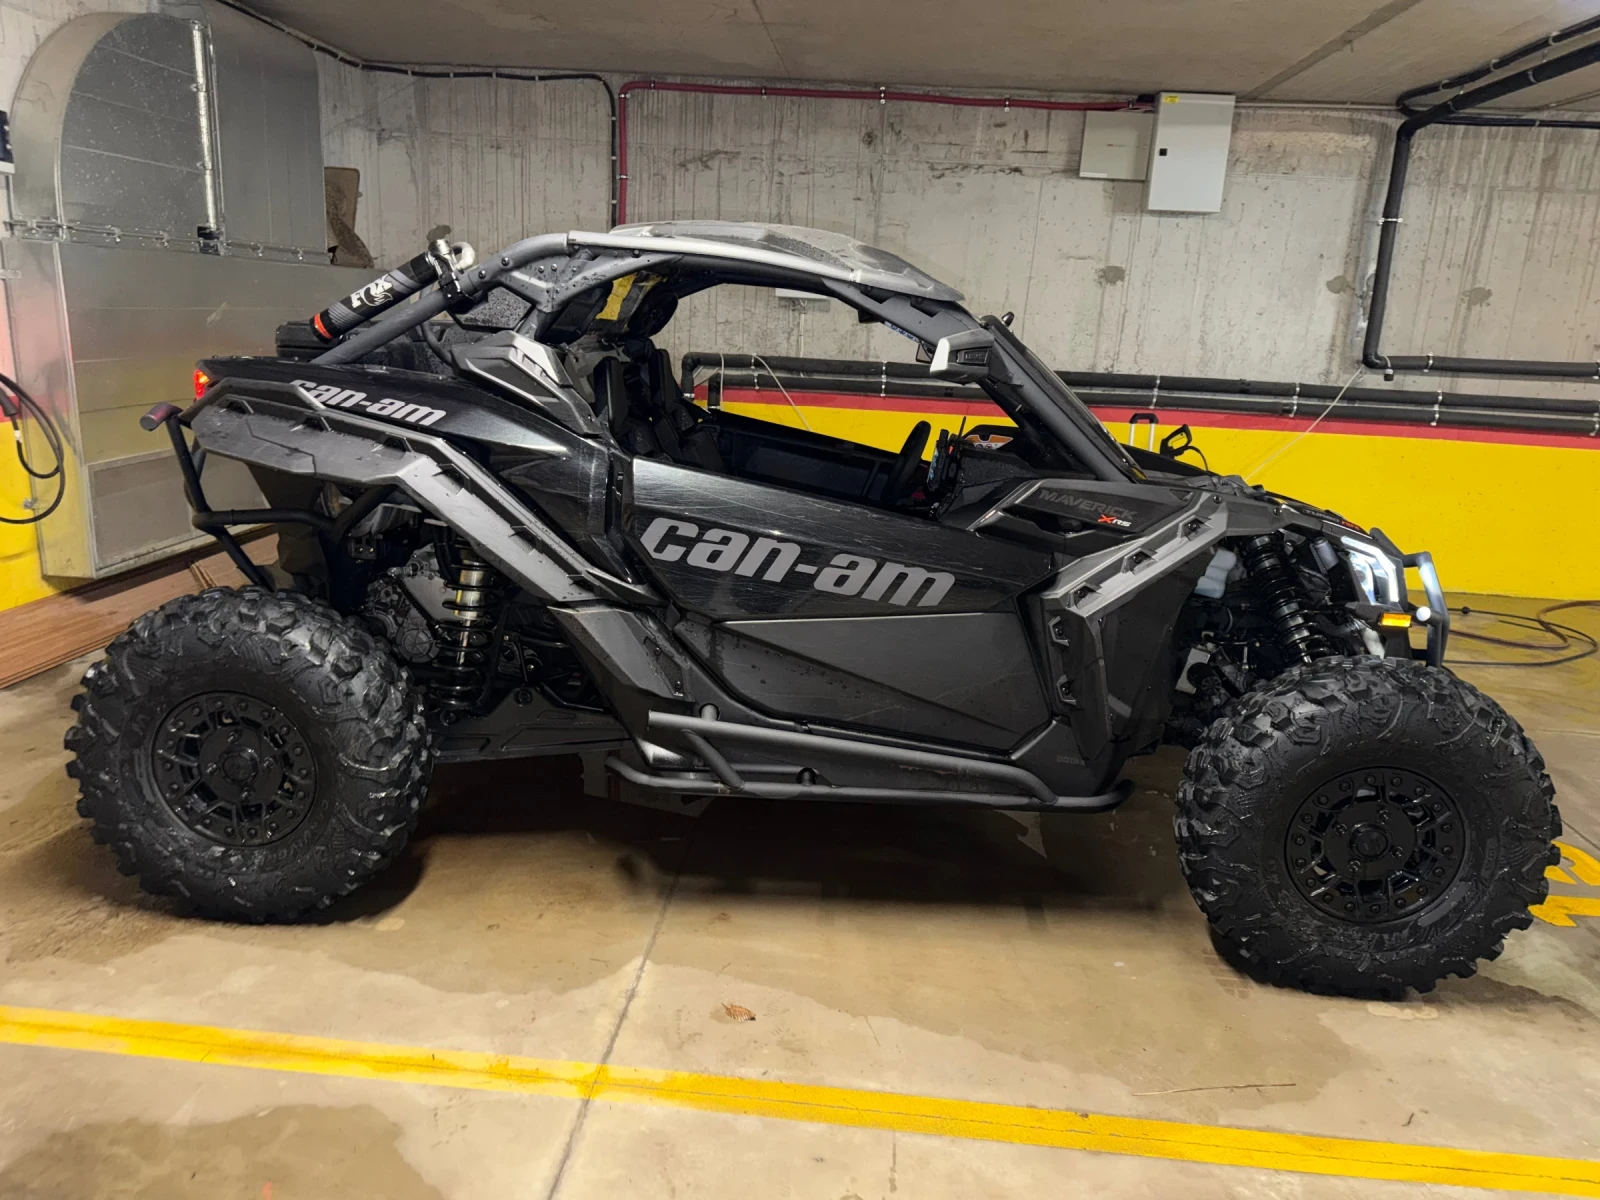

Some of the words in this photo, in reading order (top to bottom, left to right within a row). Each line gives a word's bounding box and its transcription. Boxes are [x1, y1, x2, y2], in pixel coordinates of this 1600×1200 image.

[350, 273, 393, 308] FOX
[1039, 489, 1138, 520] MAVERICK
[640, 517, 956, 607] can-am
